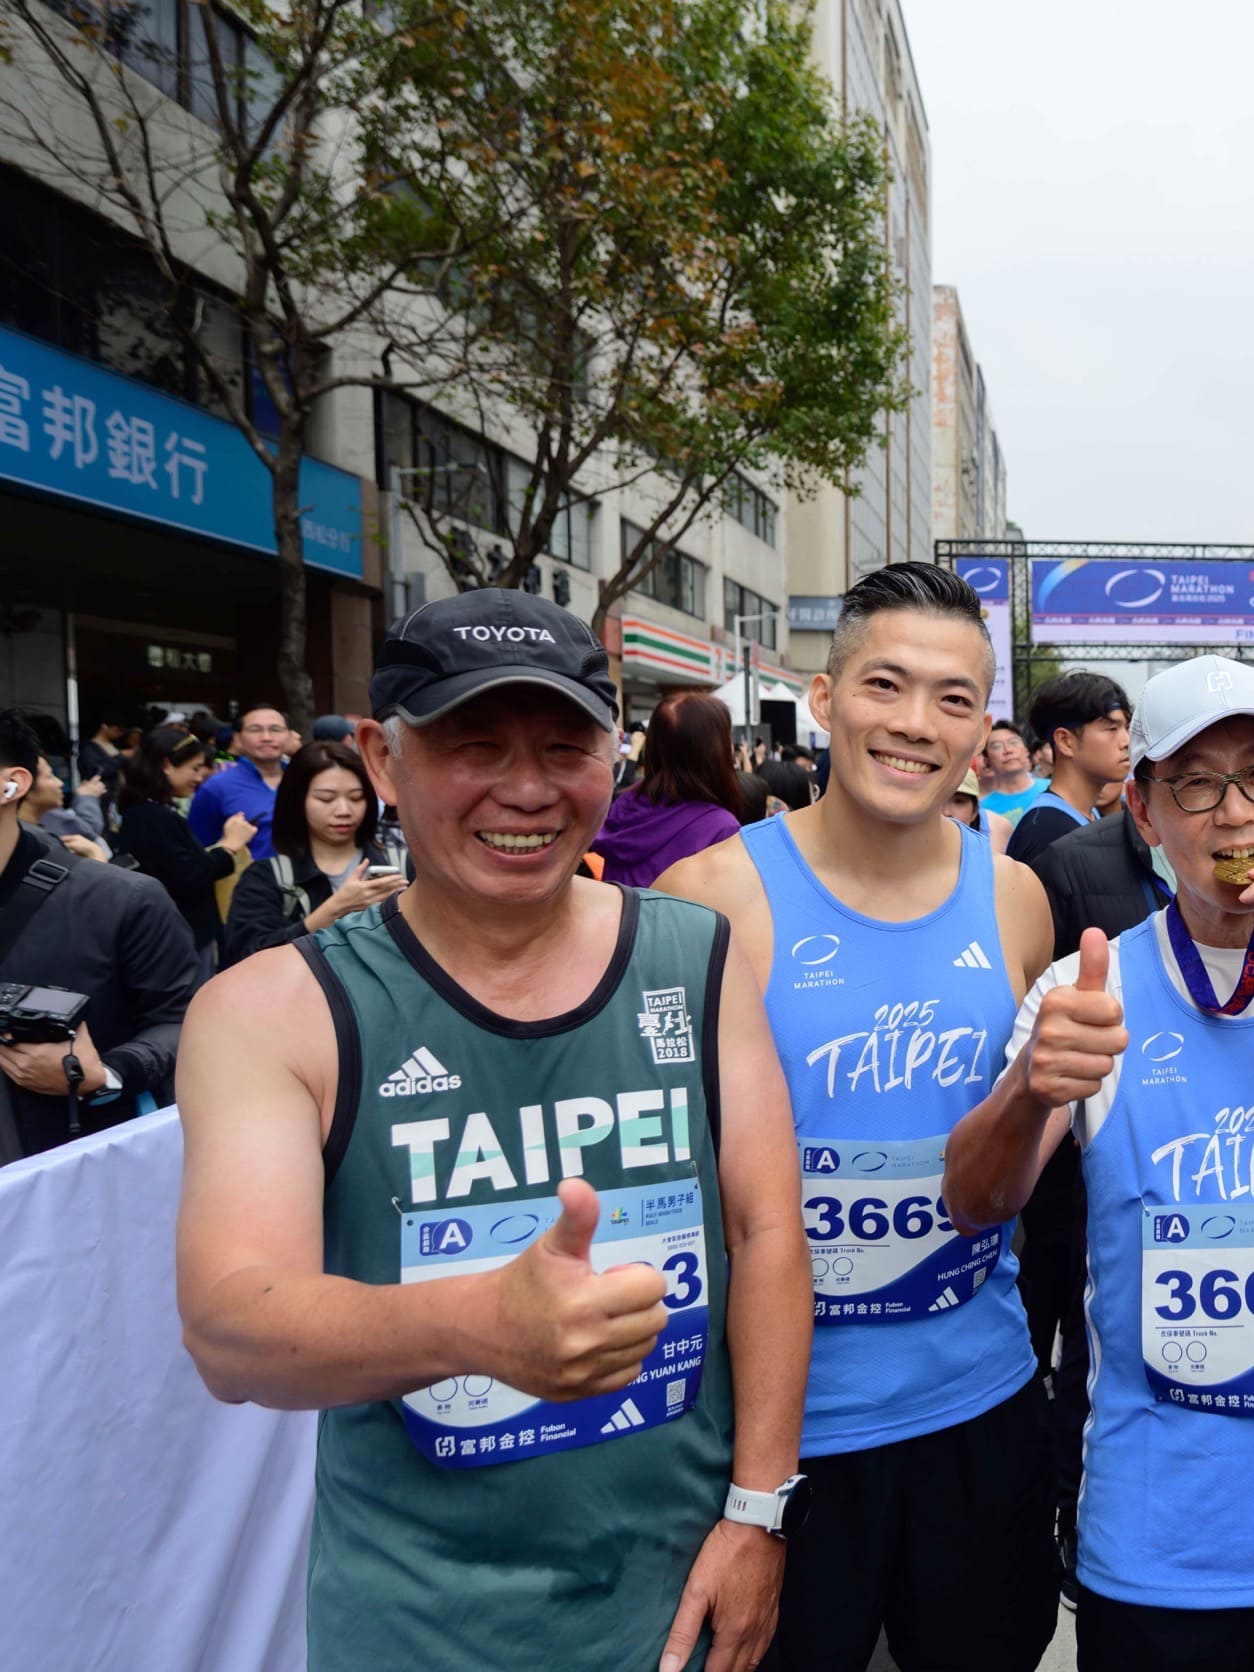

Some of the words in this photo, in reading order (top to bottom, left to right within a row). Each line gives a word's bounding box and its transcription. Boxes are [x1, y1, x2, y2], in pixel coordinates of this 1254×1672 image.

[1171, 575, 1209, 584] TAIPEI
[1170, 584, 1234, 594] MARATHON
[453, 626, 556, 643] TOYOTA
[803, 970, 834, 980] TAIPEI
[793, 978, 845, 990] MARATHON
[648, 992, 682, 1007] TAIPEI
[650, 1005, 683, 1013] MARATHON
[873, 1000, 940, 1031] 2025
[656, 1037, 688, 1048] 馬拉松
[658, 1047, 688, 1058] 2018
[806, 1027, 988, 1098] TAIPEI
[1152, 1067, 1177, 1076] TAIPEI
[378, 1074, 462, 1098] adidas
[1142, 1076, 1188, 1086] MARATHON
[391, 1087, 692, 1204] TAIPEI
[816, 1150, 836, 1170] A
[645, 1191, 694, 1211] 半馬男子組
[1166, 1217, 1186, 1238] A
[439, 1222, 467, 1249] A
[937, 1267, 960, 1281] HUNG
[960, 1258, 982, 1273] CHING
[829, 1303, 882, 1317] 富邦金控
[885, 1306, 911, 1314] Financial
[662, 1334, 703, 1360] 甘中元
[649, 1364, 676, 1380] YUAN
[677, 1356, 702, 1373] KANG
[1187, 1394, 1240, 1408] 富邦金控
[540, 1423, 566, 1434] Fubon
[540, 1428, 577, 1442] Financial
[460, 1429, 536, 1456] 富邦金控
